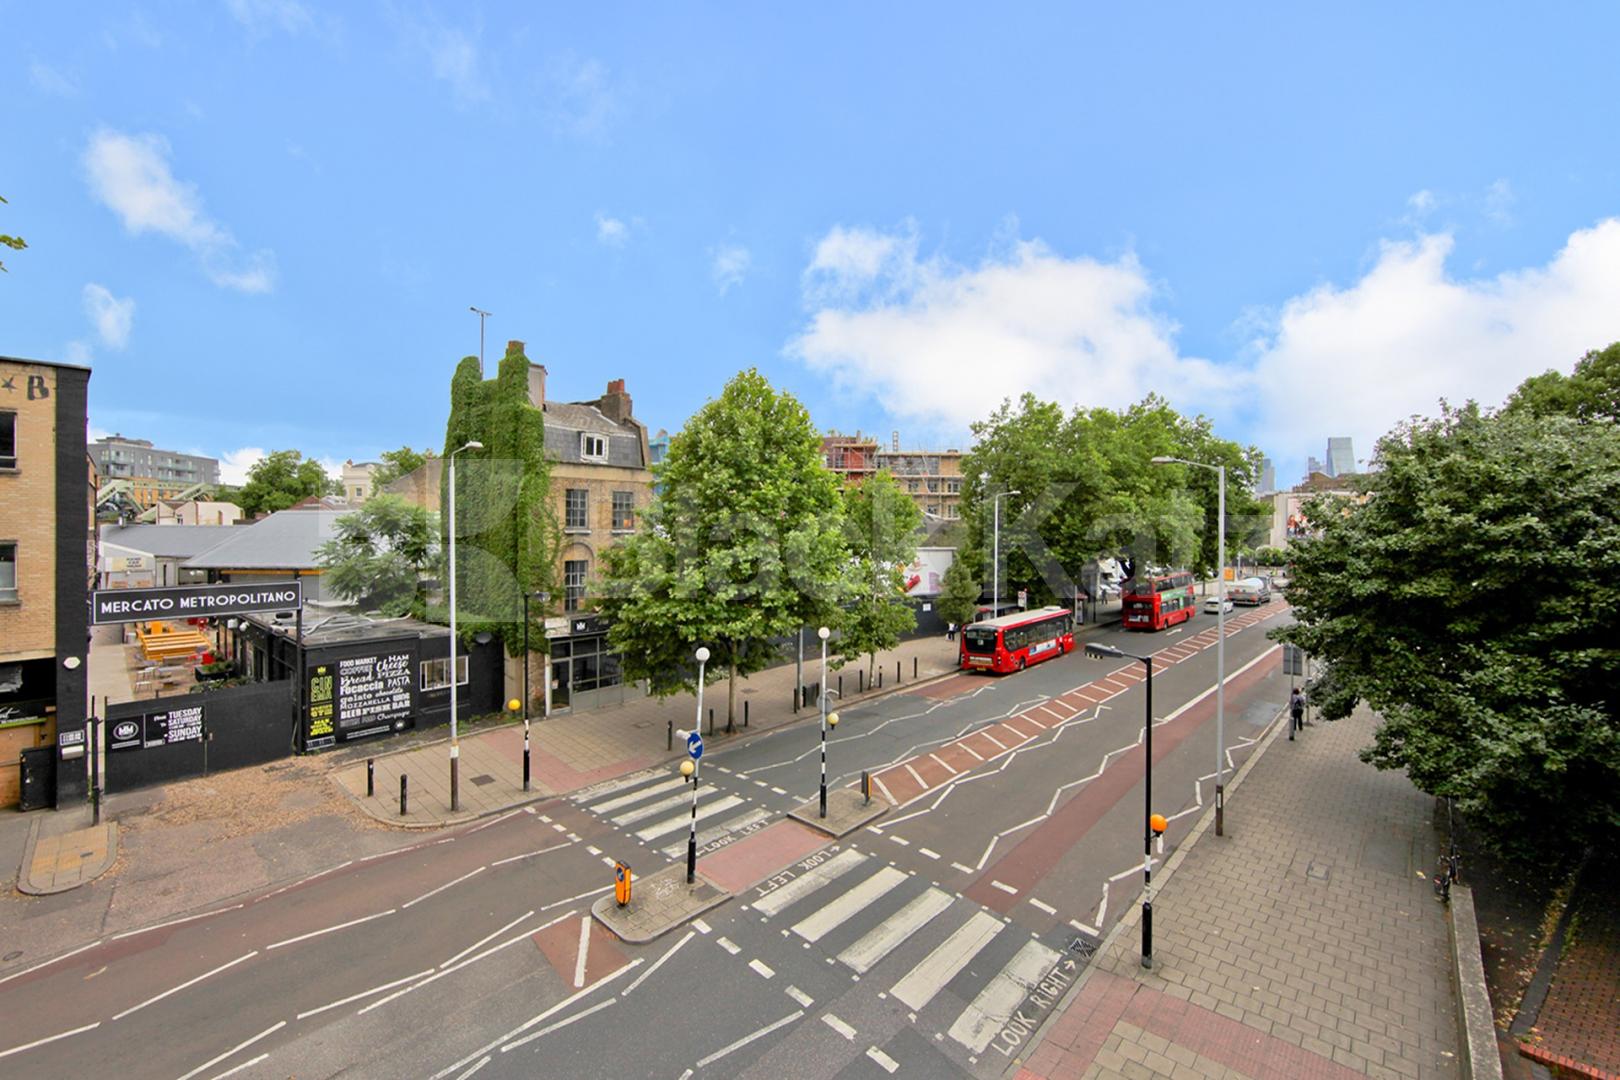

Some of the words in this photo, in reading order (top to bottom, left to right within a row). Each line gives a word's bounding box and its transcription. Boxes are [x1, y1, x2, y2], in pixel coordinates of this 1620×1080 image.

[101, 598, 174, 614] MERCATO
[180, 591, 296, 609] METROPOLITANO
[340, 660, 355, 668] FOOD
[355, 657, 377, 666] MARKET
[377, 669, 411, 679] PIZZA
[388, 676, 410, 687] PASTA
[340, 697, 390, 710] MOZZARELLA
[341, 709, 361, 719] BEER
[392, 700, 410, 709] BAR
[168, 706, 202, 719] TUESDAY
[168, 714, 202, 726] SATURDAY
[168, 725, 202, 740] SUNDAY
[703, 835, 737, 853] LOOK
[741, 819, 769, 835] LEFT
[797, 850, 832, 871] LOOK
[755, 870, 796, 897] LEFT
[991, 1011, 1037, 1057] LOOK
[1029, 967, 1071, 1009] RIGHT
